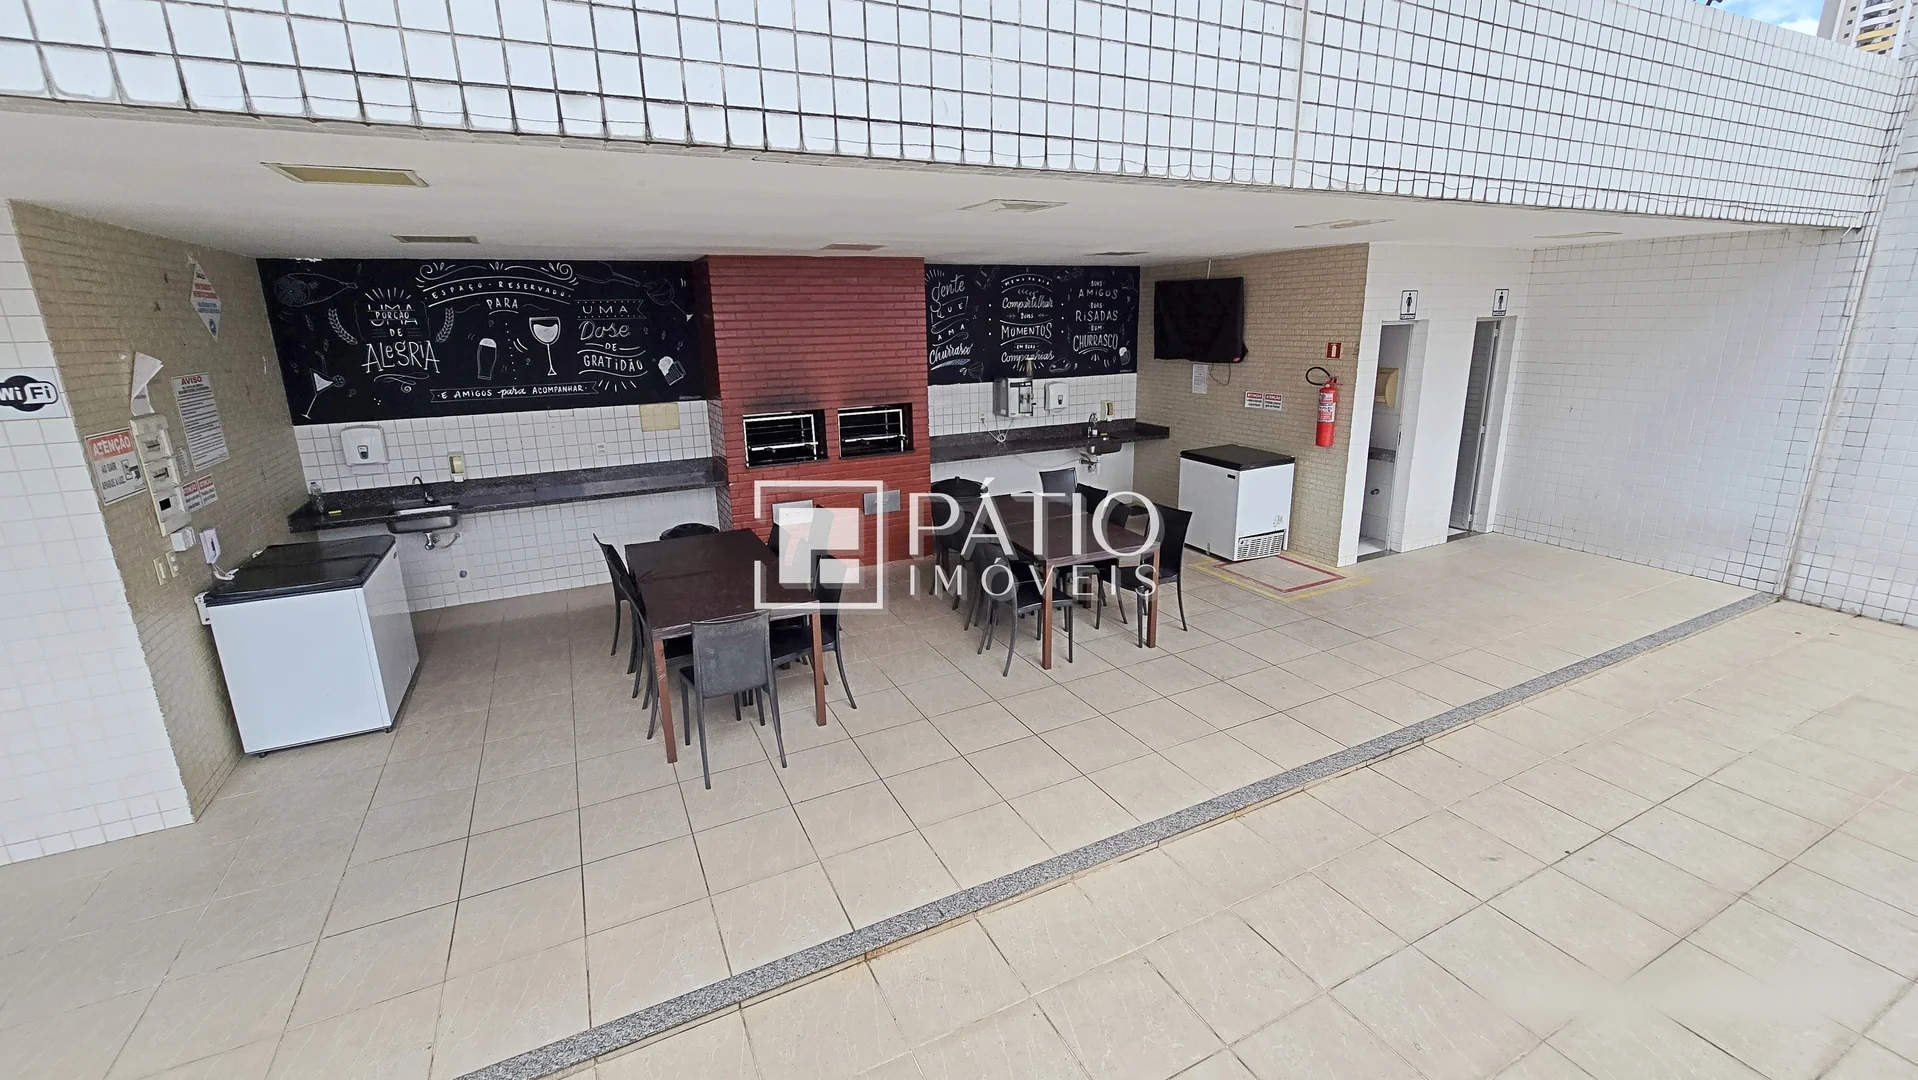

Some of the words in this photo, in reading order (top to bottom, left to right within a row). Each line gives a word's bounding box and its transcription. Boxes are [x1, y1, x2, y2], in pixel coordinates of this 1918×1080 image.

[498, 281, 565, 297] RESERVADO
[1078, 288, 1118, 300] AMIGOS
[486, 298, 518, 309] PARA
[582, 305, 628, 314] UMA
[389, 328, 403, 337] DE
[578, 320, 631, 340] Dose
[937, 324, 965, 341] AMA
[1001, 322, 1053, 340] MOMENTOS
[604, 342, 617, 352] DE
[1073, 333, 1119, 352] CHURRASCO
[929, 343, 974, 365] Churrasco
[181, 376, 203, 386] AVISO
[498, 386, 527, 398] para
[532, 385, 584, 395] ACOMPANHAR
[92, 434, 132, 457] ATENÇÃO
